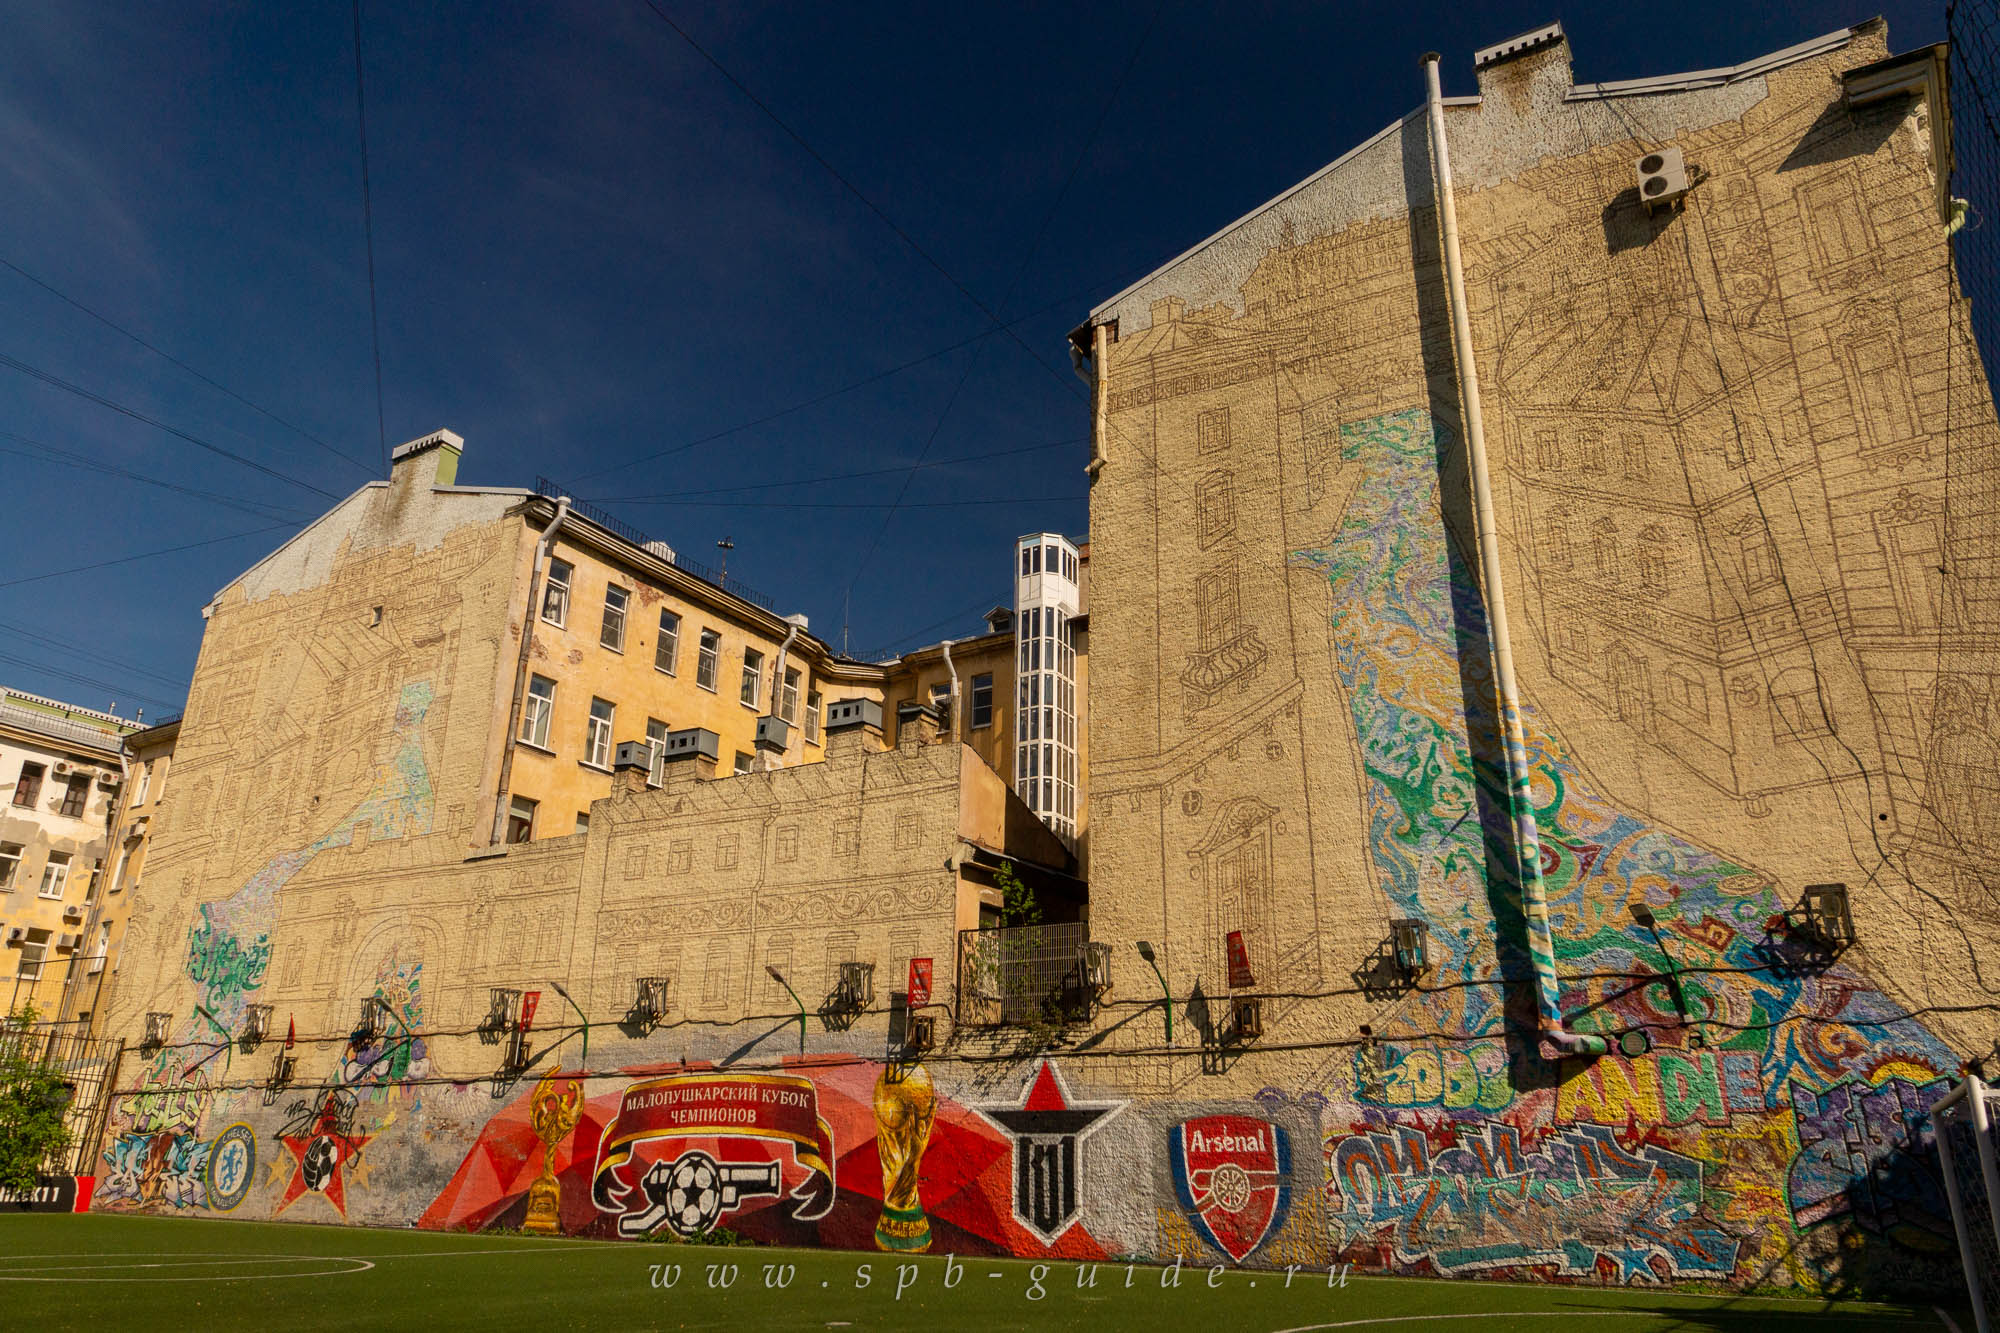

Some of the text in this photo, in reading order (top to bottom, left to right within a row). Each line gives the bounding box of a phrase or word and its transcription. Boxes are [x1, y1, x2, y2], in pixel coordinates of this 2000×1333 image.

[626, 1084, 810, 1112] МАЛОПУШКАРСКИЙ КУБОК
[671, 1107, 757, 1124] ЧЕМПИОНОВ
[222, 1128, 252, 1146] CHELSEA
[1190, 1128, 1266, 1153] Arsenal
